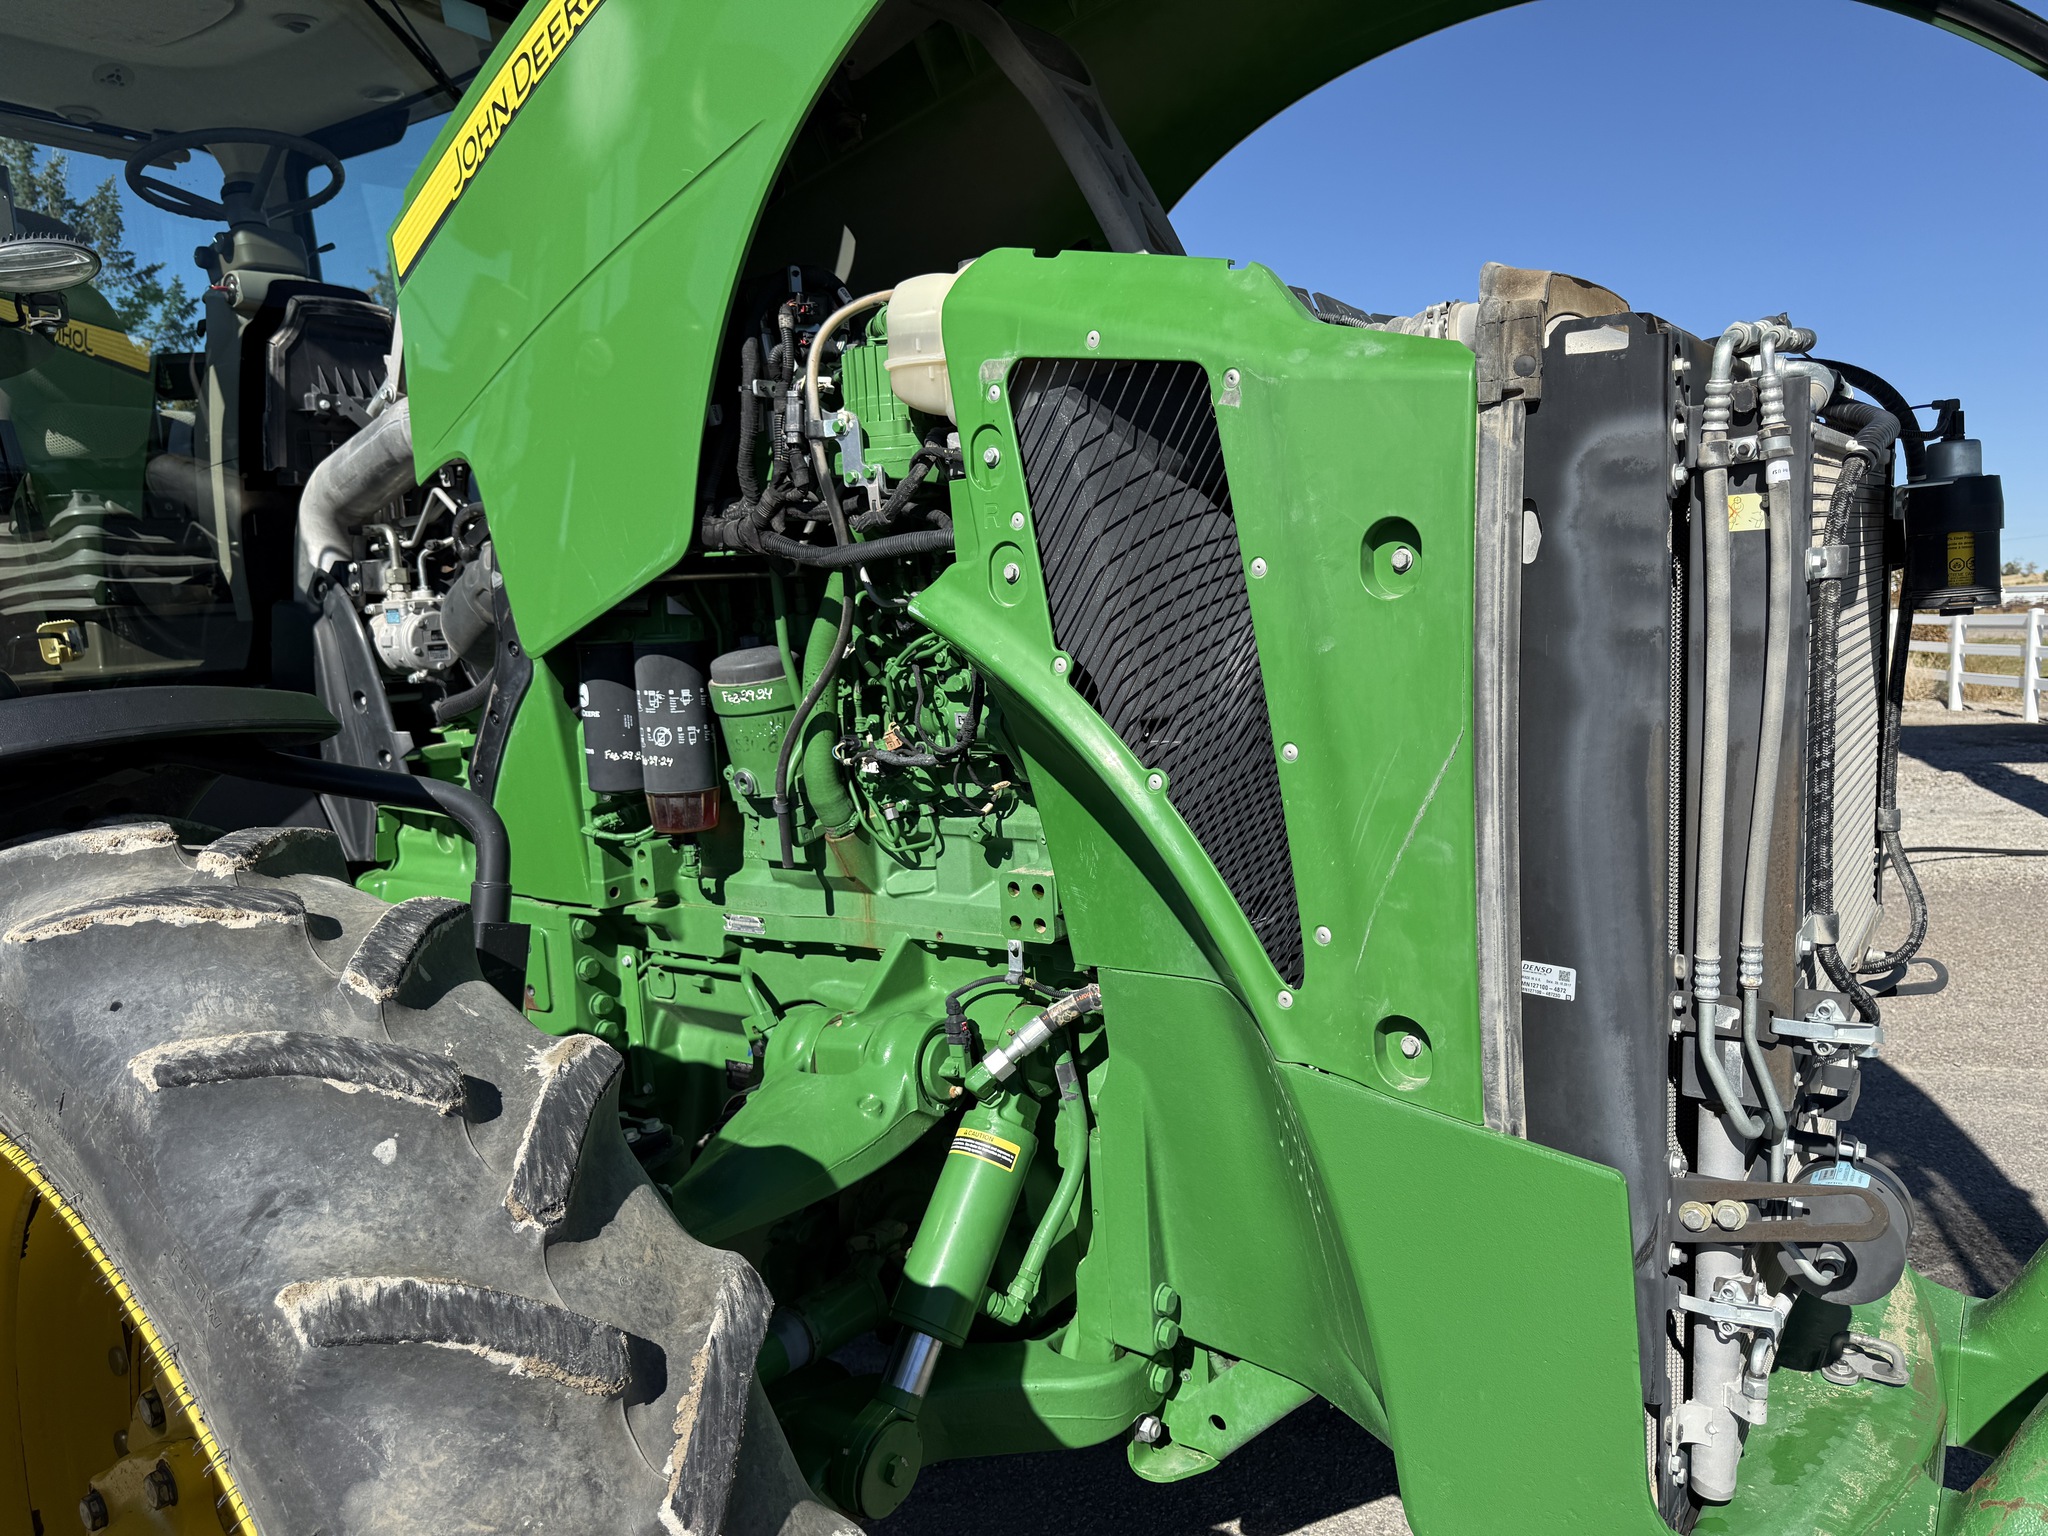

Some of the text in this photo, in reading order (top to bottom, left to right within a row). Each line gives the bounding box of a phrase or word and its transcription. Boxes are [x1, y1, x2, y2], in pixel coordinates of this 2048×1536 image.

[453, 85, 510, 191] JOHN
[1522, 963, 1553, 974] DENSO
[967, 1130, 995, 1142] CAUTION
